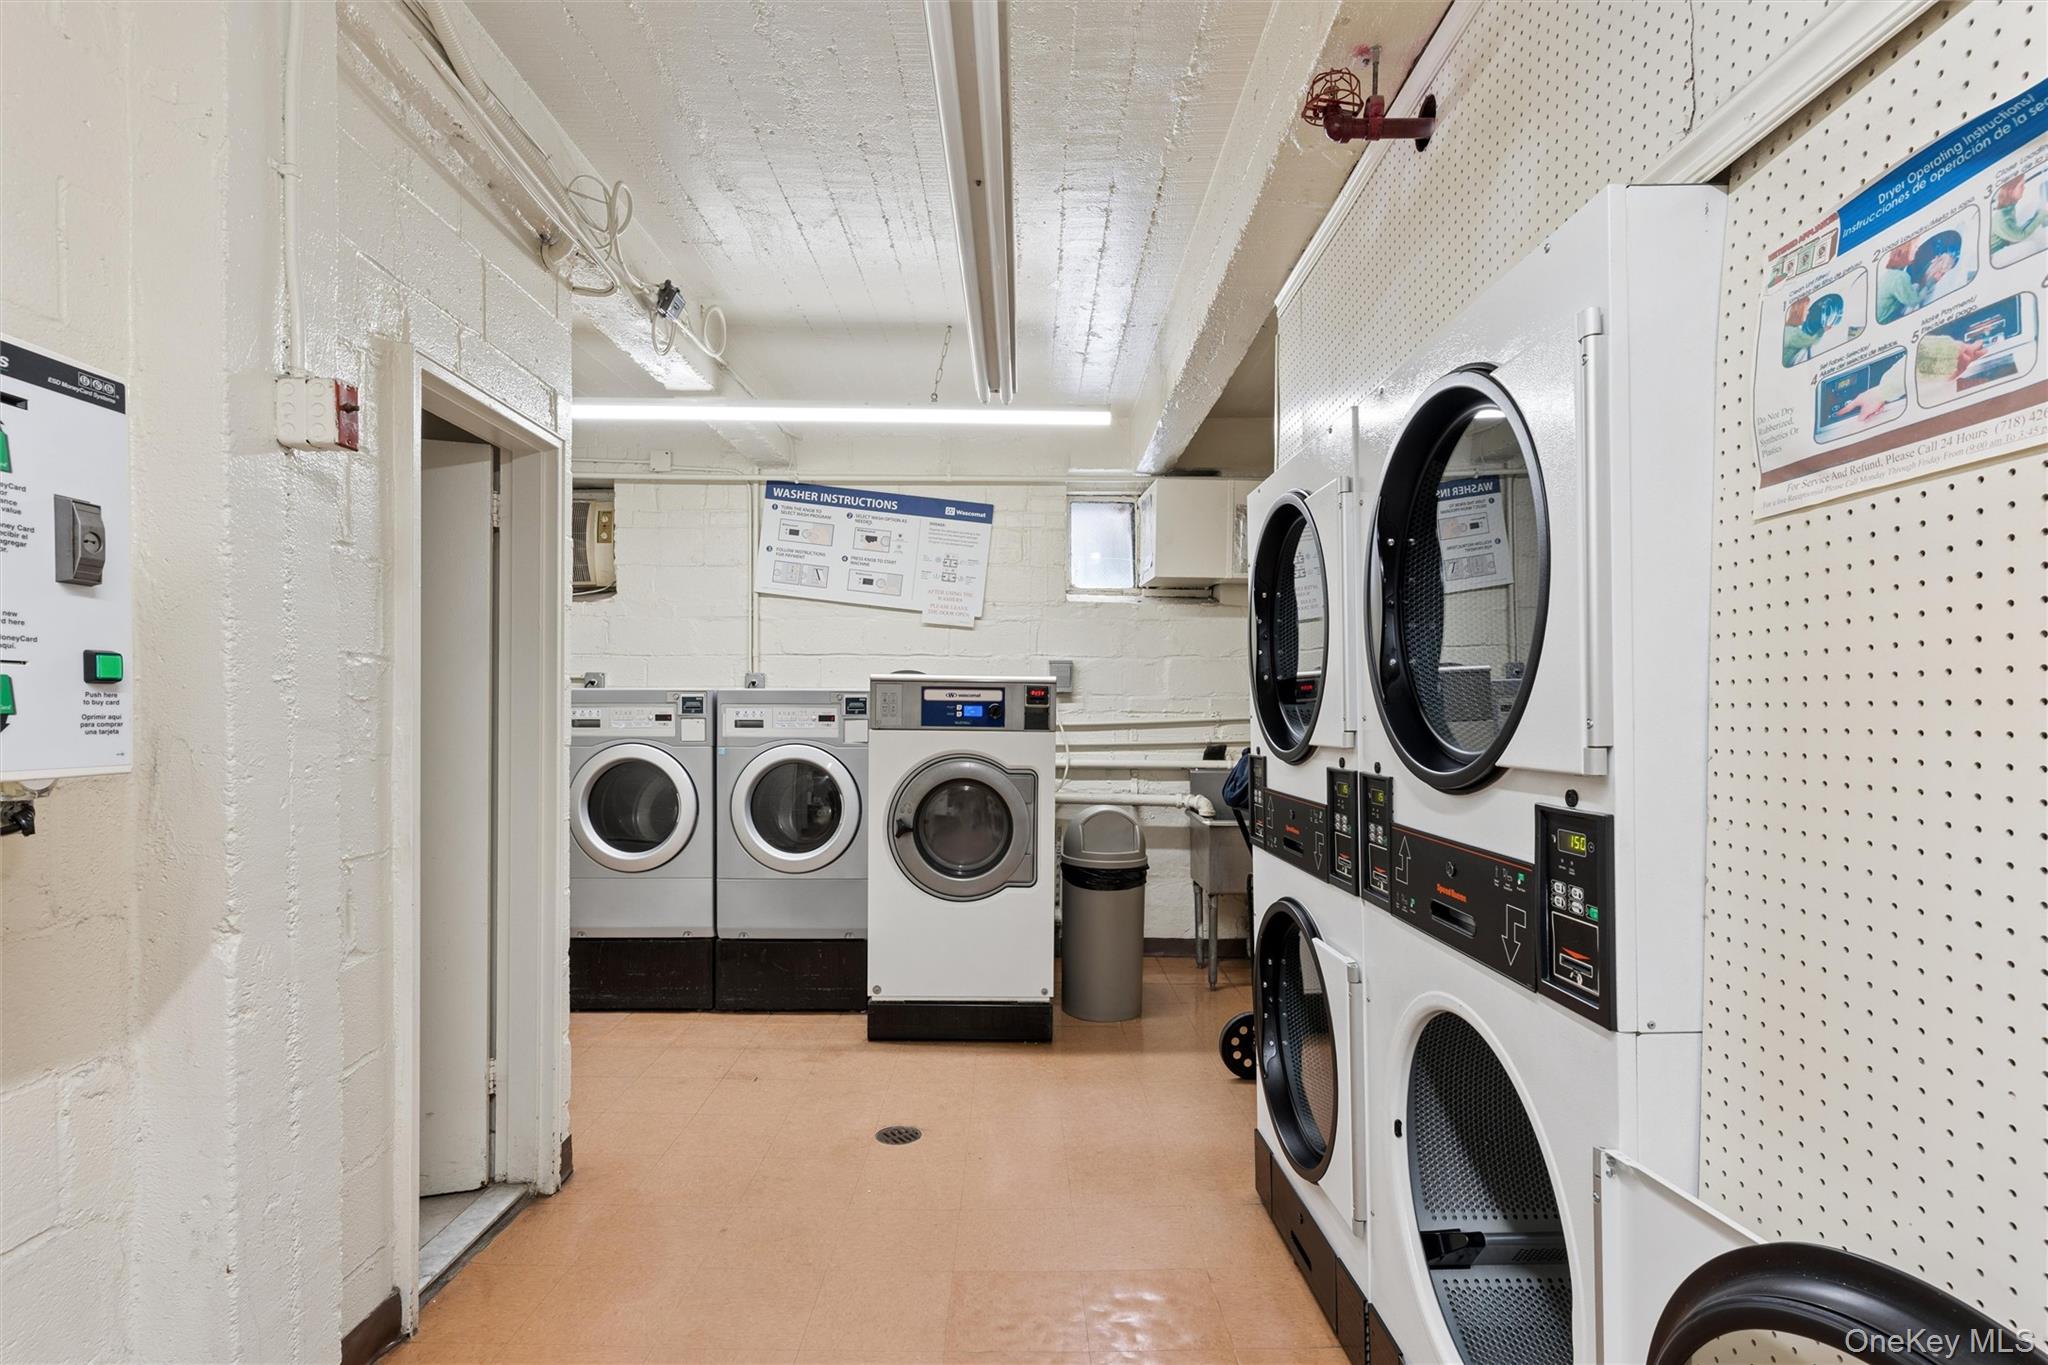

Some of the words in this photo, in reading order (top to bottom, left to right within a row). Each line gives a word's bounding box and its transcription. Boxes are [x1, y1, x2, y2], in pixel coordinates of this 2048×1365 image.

[1912, 180, 1927, 195] de
[1929, 138, 1992, 182] operación
[1993, 124, 2011, 141] de
[2012, 115, 2027, 127] la
[1878, 181, 1905, 205] Dryer
[1907, 141, 1963, 184] Operating
[1984, 184, 1993, 200] 3
[1872, 249, 1881, 263] 2
[1911, 329, 1920, 344] 5
[1811, 374, 1818, 386] 4
[1768, 411, 1780, 422] Not
[1781, 407, 1795, 419] Dry
[1786, 482, 1798, 493] For
[1801, 475, 1830, 489] Service
[1832, 469, 1848, 480] And
[1885, 449, 1915, 465] Please
[1917, 441, 1938, 456] Call
[1940, 437, 1953, 450] 24
[1956, 427, 1989, 445] Hours
[1994, 415, 2026, 434] (718)
[1888, 461, 1916, 476] Through
[1918, 455, 1942, 470] Friday
[1943, 449, 1964, 460] From
[2005, 433, 2016, 443] To
[773, 487, 818, 501] WASHER
[820, 493, 898, 510] INSTRUCTIONS
[2, 506, 22, 515] value
[956, 510, 986, 518] Wascomat
[17, 525, 35, 534] Card
[8, 618, 25, 626] here
[1571, 835, 1586, 851] 150
